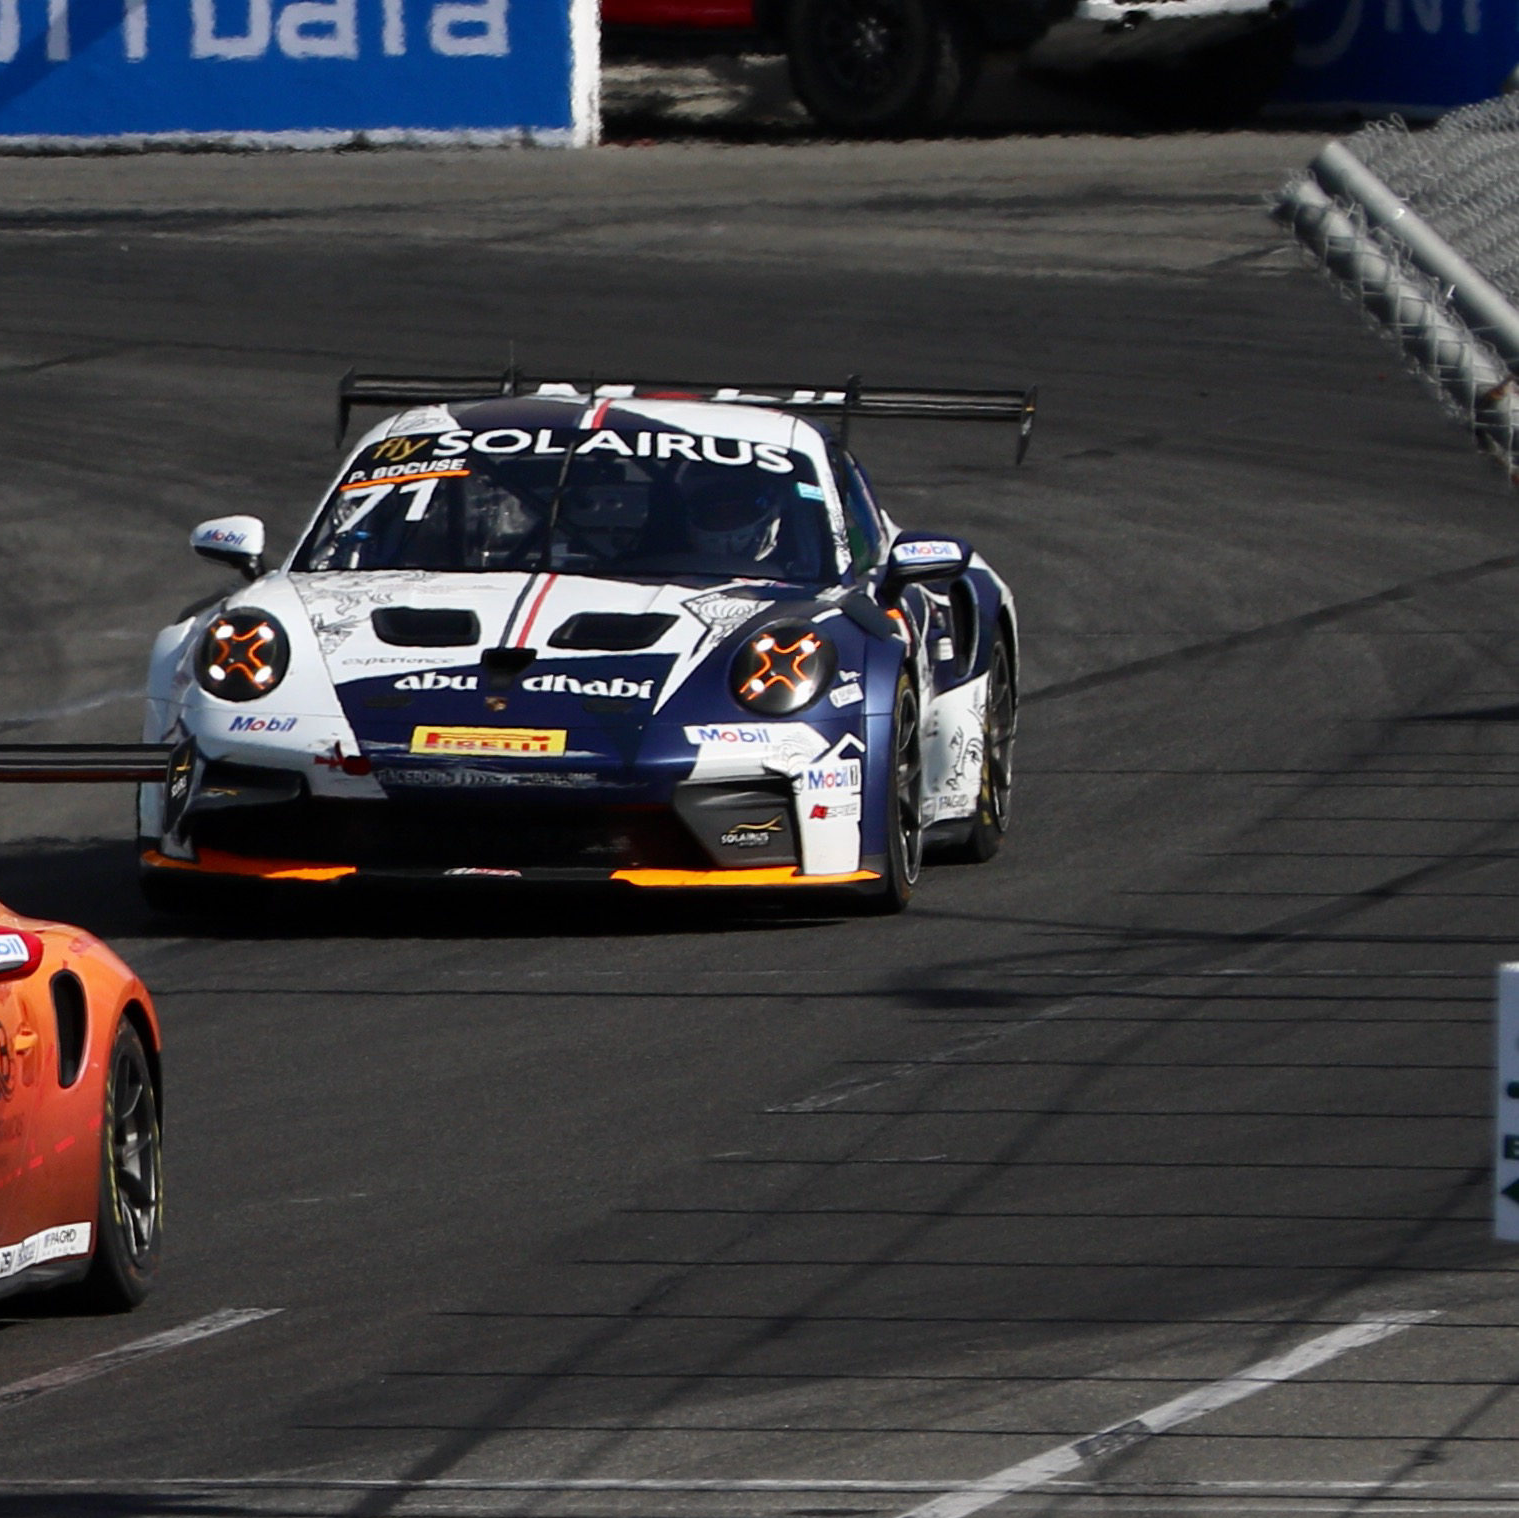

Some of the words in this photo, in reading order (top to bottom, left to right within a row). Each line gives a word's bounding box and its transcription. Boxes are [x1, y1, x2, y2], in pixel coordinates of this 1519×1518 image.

[372, 437, 431, 461] fly
[432, 428, 794, 474] SOLAIRUS
[349, 470, 368, 484] P.
[372, 458, 467, 481] BOCUSE
[335, 478, 440, 535] 71
[201, 529, 247, 546] Mobil
[902, 542, 953, 557] Mobil
[393, 671, 479, 691] abu
[522, 673, 655, 700] dhabi
[228, 716, 298, 733] Mobil
[424, 732, 551, 752] PIRELLI
[699, 728, 771, 744] Mobil
[808, 767, 848, 790] Mobil
